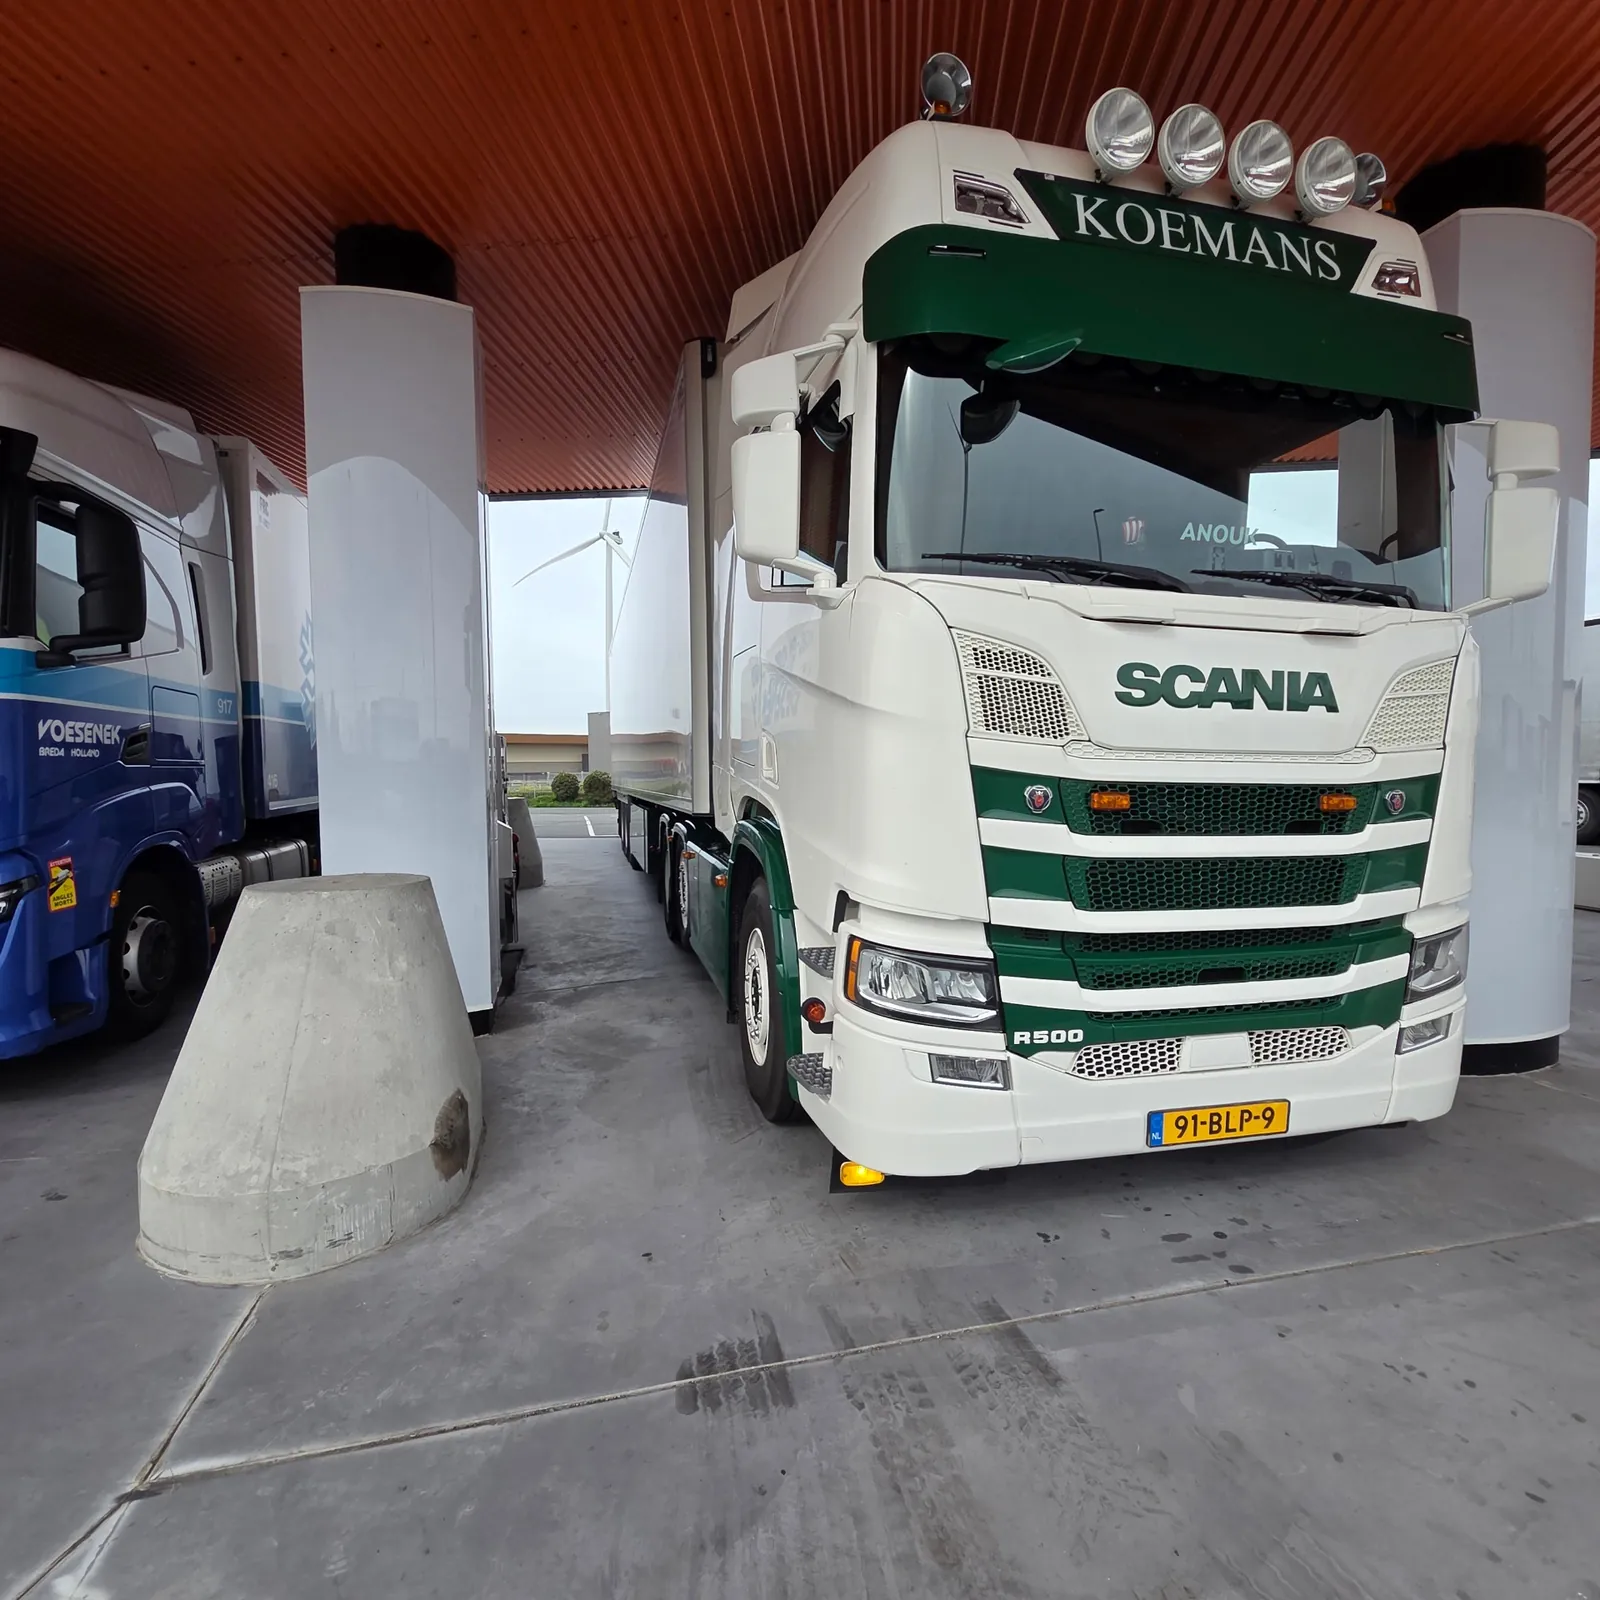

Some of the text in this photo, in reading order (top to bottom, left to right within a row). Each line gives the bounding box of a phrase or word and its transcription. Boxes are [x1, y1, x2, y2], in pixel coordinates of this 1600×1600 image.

[1071, 193, 1342, 281] KOEMANS
[1179, 521, 1260, 546] ANOUK
[1114, 661, 1340, 714] SCANIA
[217, 697, 233, 715] 917
[37, 718, 122, 745] VOESENEK
[38, 746, 100, 758] BREDA HOLLAND
[53, 893, 73, 901] ANGLES
[54, 898, 73, 907] MORTS
[1013, 1029, 1084, 1045] R500
[1151, 1106, 1276, 1140] NL 91-BLP-9
